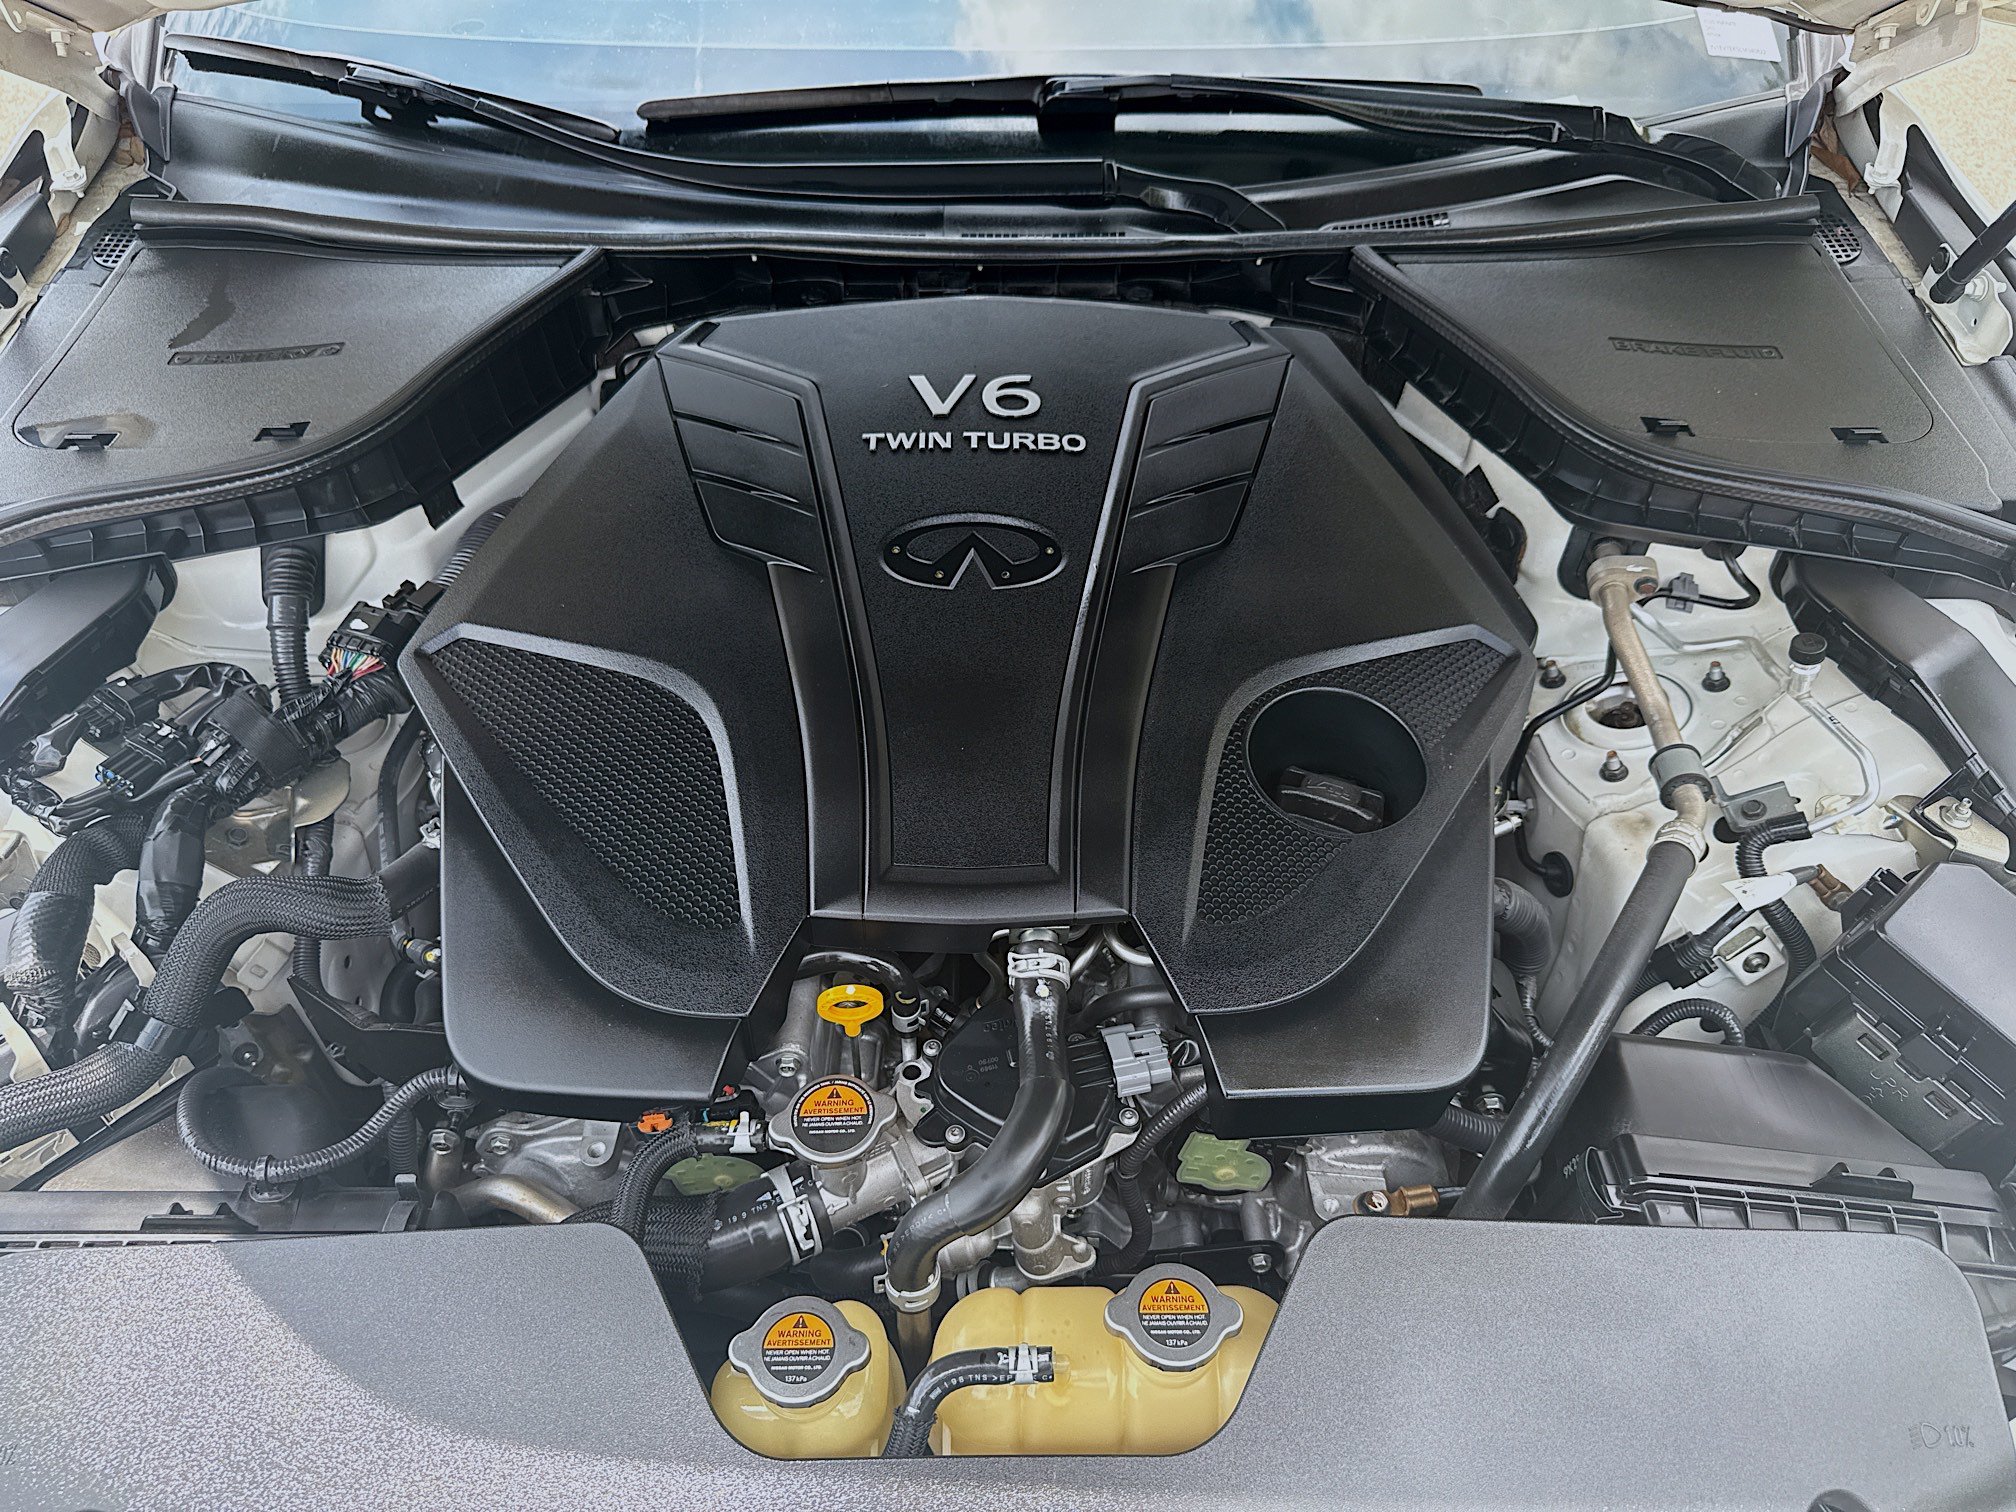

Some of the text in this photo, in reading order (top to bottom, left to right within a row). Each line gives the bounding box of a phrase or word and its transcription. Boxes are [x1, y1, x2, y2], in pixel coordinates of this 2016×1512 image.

[1613, 339, 1778, 360] BRAKE FLUID
[908, 374, 1042, 418] V6
[862, 431, 1087, 452] TWIN TURBO
[814, 1099, 854, 1107] WARNING
[803, 1107, 864, 1115] AVERTISSEMENT
[751, 1201, 768, 1214] TNS
[1151, 1295, 1195, 1303] WARNING
[778, 1330, 822, 1338] WARNING
[767, 1338, 831, 1347] AVERTISSEMENT
[968, 1374, 988, 1382] TNS
